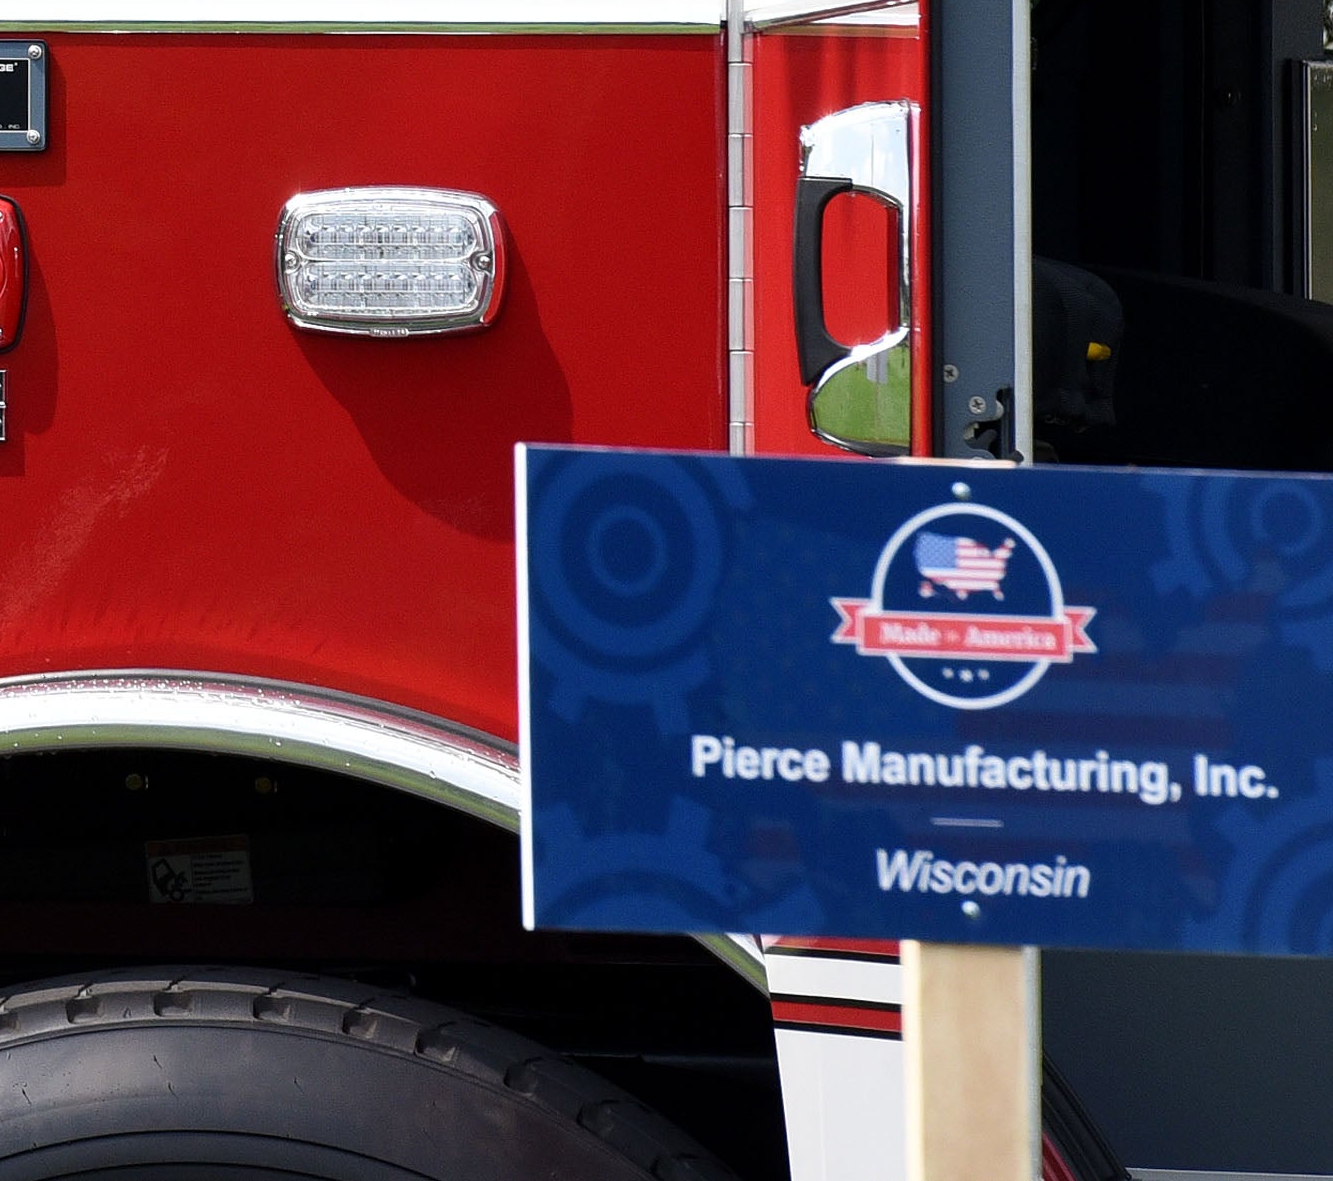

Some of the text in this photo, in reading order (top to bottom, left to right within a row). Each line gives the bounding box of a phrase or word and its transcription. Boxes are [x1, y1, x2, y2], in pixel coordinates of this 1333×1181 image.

[880, 621, 942, 647] Made
[964, 625, 1056, 650] America
[691, 735, 1279, 804] Pierce Manufacturing, Inc.
[876, 849, 1091, 898] Wisconsin
